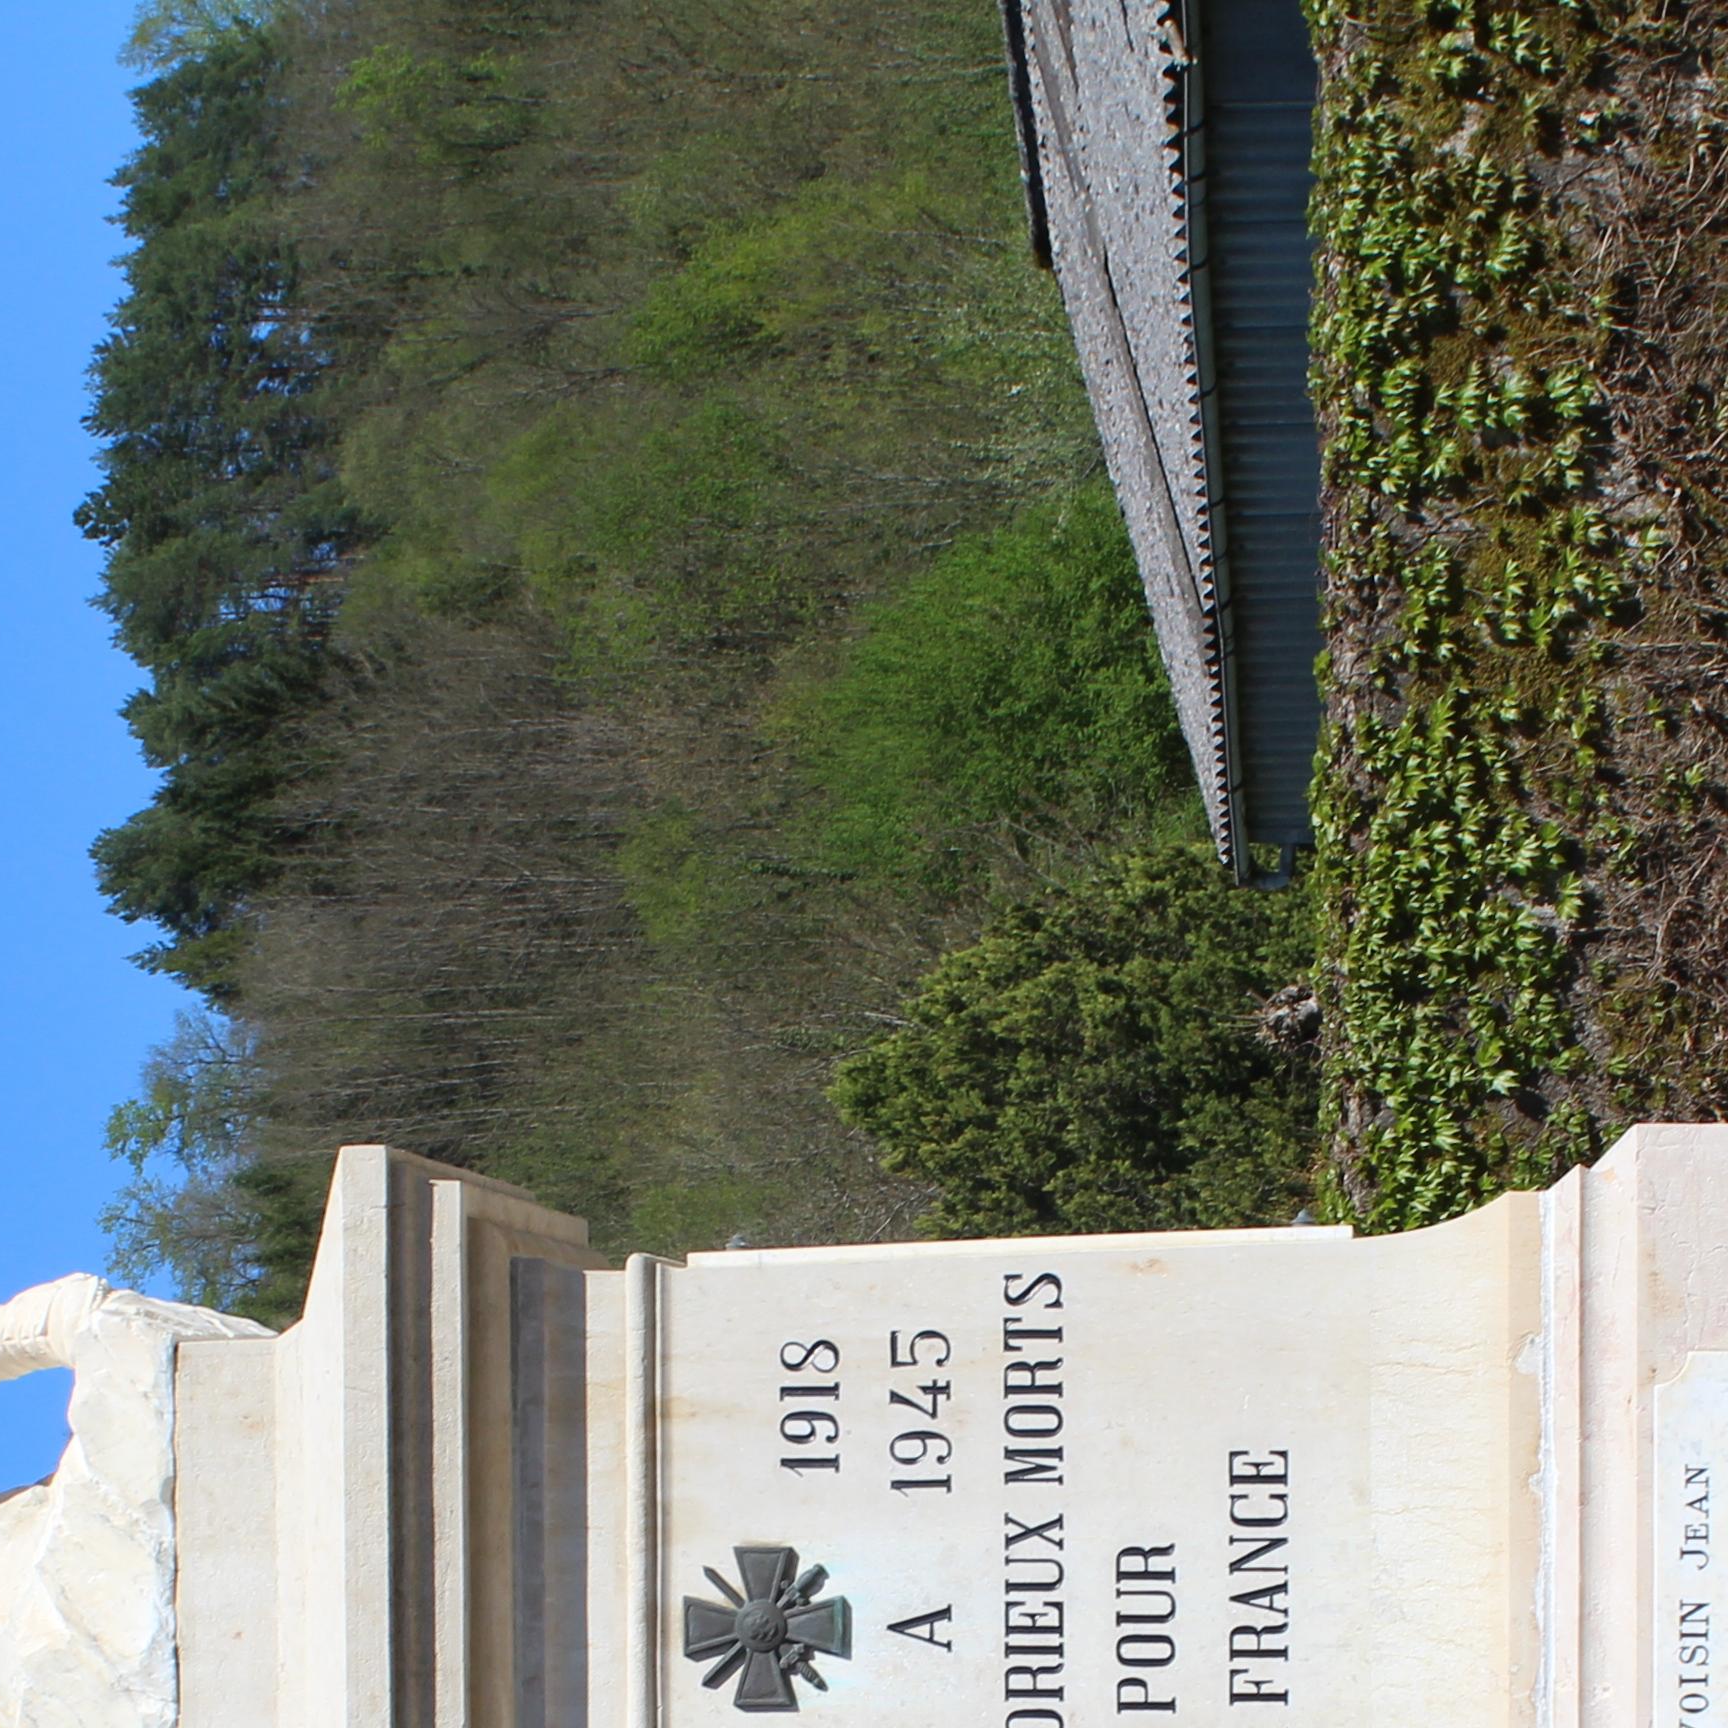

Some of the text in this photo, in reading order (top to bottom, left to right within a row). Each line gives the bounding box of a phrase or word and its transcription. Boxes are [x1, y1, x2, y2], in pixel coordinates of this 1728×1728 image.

[779, 1340, 840, 1474] 1918
[889, 1329, 952, 1494] 1945
[1003, 1272, 1064, 1486] MORTS
[1228, 1449, 1289, 1706] FRANCE
[1679, 1464, 1709, 1571] JEAN
[886, 1603, 953, 1653] A
[1115, 1542, 1177, 1715] POUR
